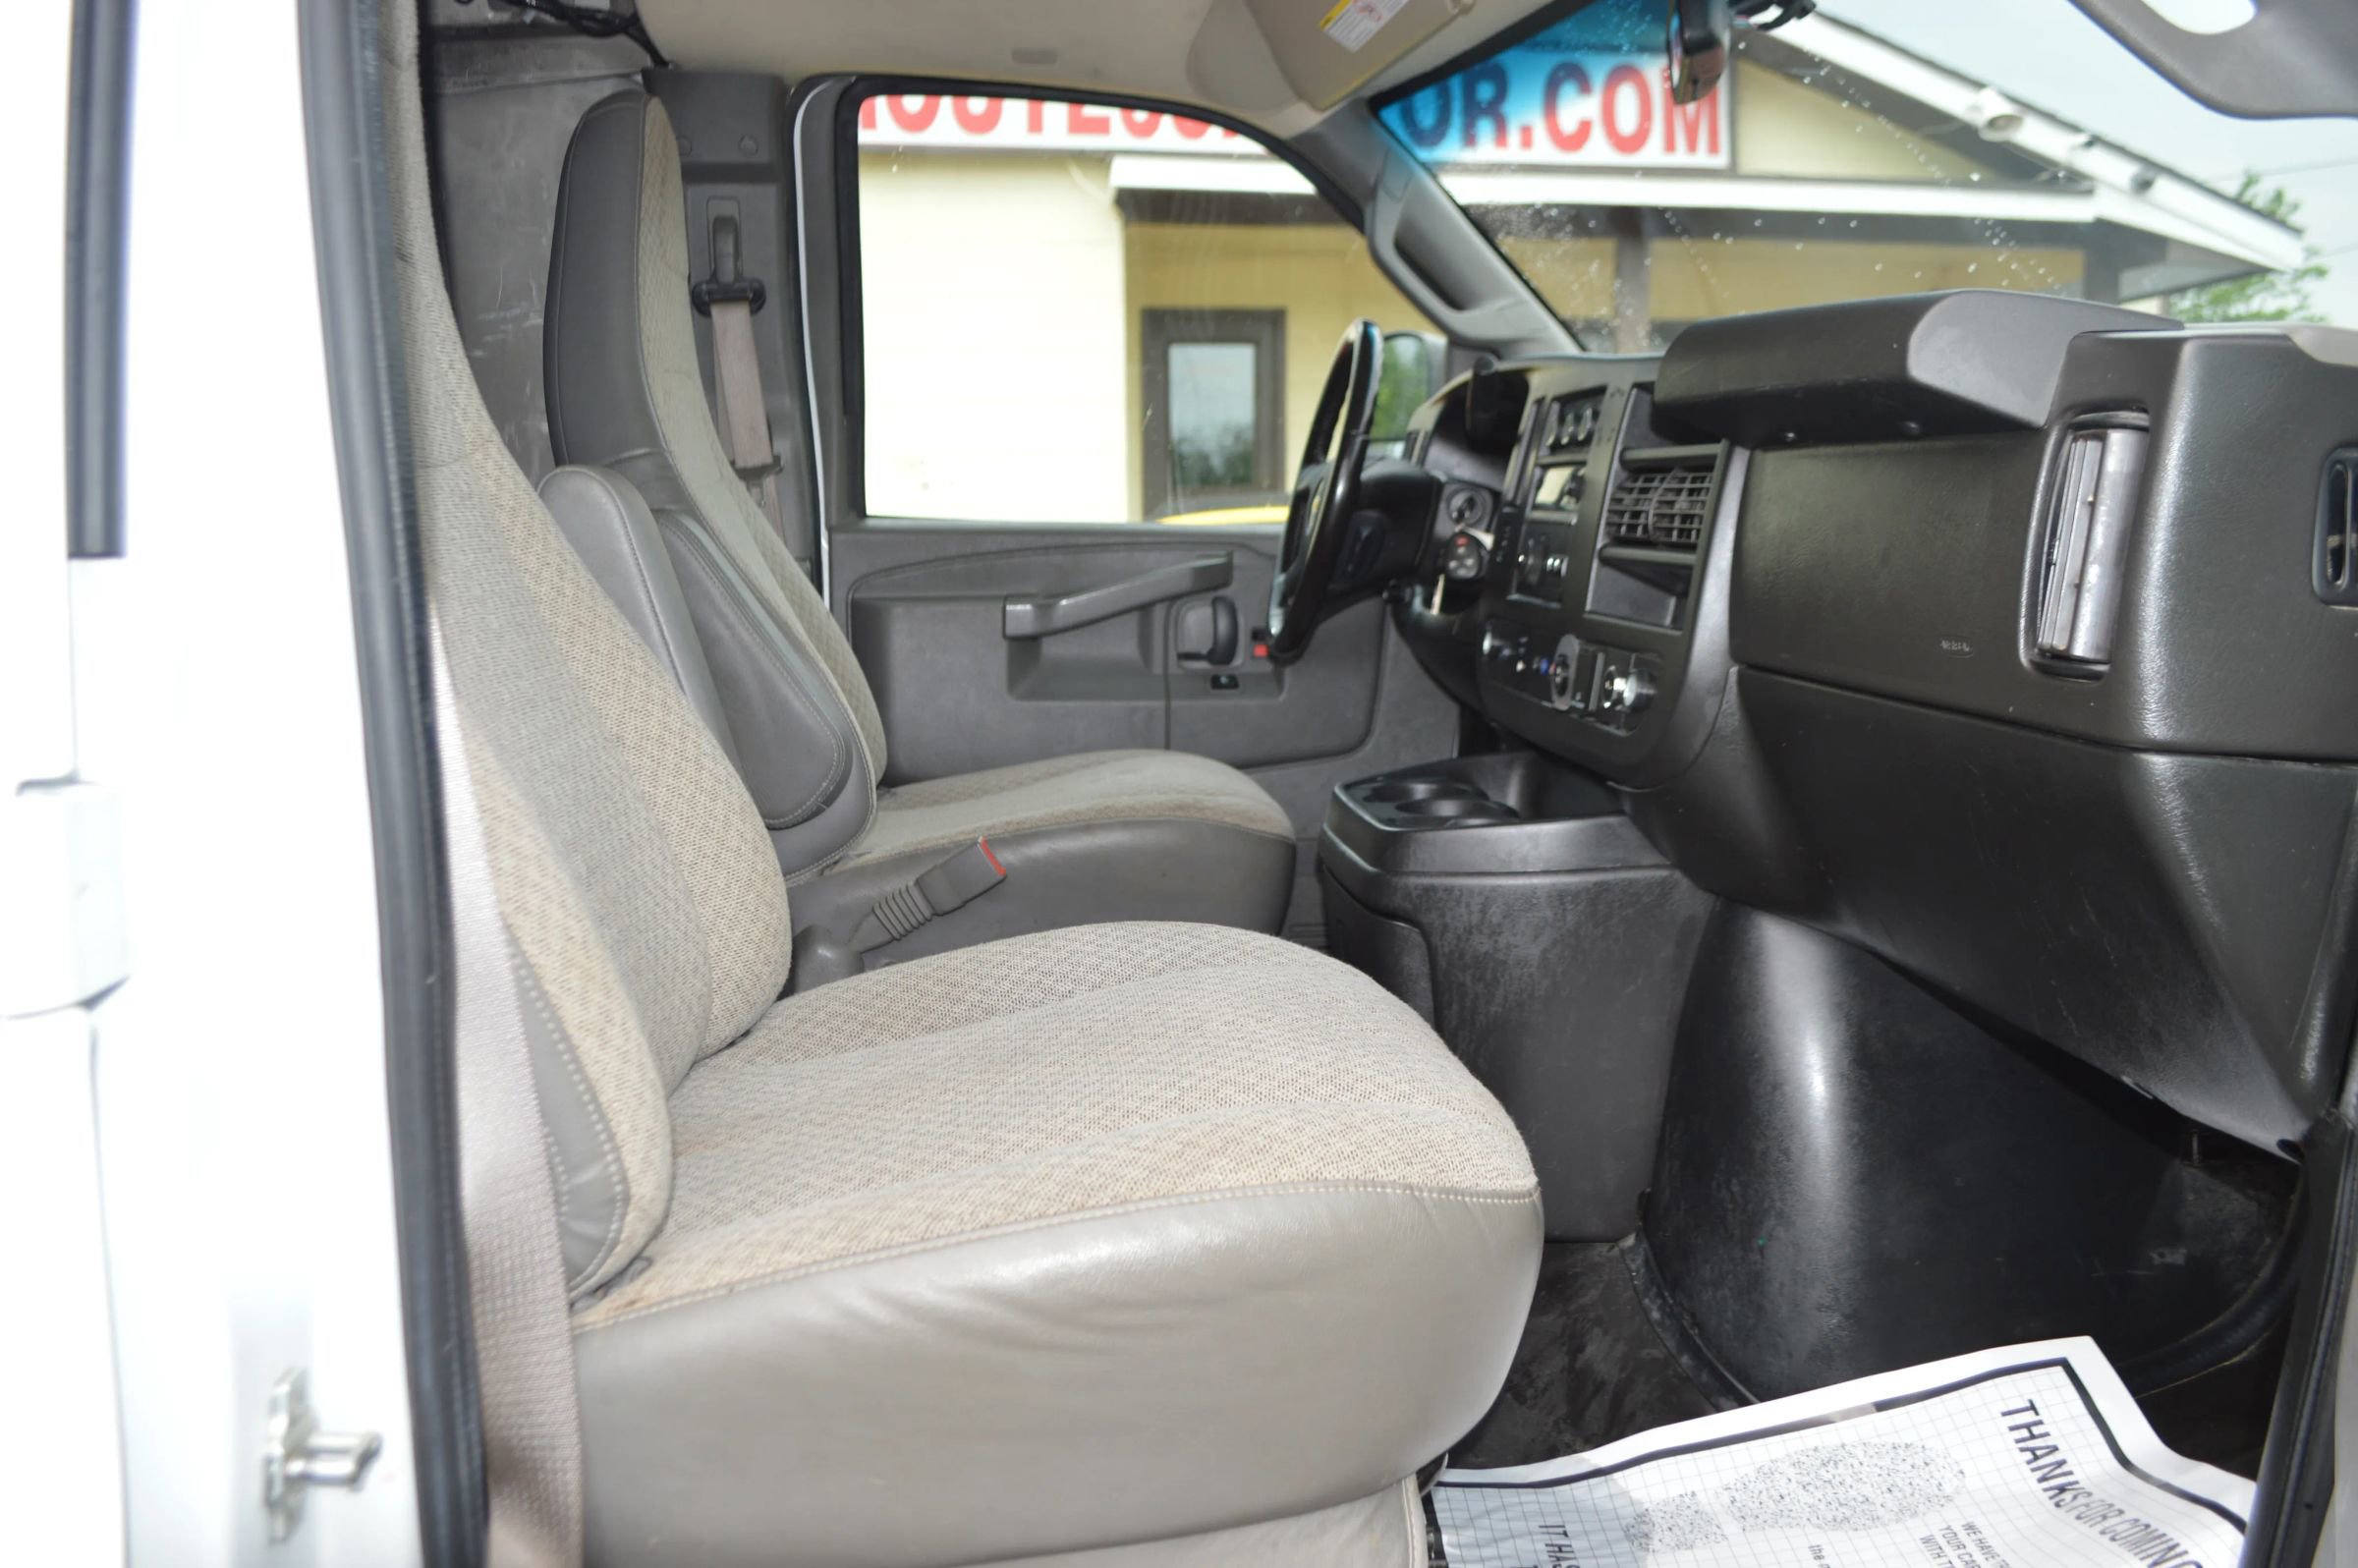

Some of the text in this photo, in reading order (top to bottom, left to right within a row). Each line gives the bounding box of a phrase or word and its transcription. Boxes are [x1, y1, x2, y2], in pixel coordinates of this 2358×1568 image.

[2000, 1399, 2093, 1508] THANKS
[2065, 1499, 2125, 1529] FOR
[1938, 1525, 1967, 1551] YOUR
[1962, 1522, 1983, 1538] WE
[1539, 1525, 1581, 1568] IT HA
[1919, 1535, 1948, 1559] WITH
[1972, 1538, 2000, 1561] HAVE
